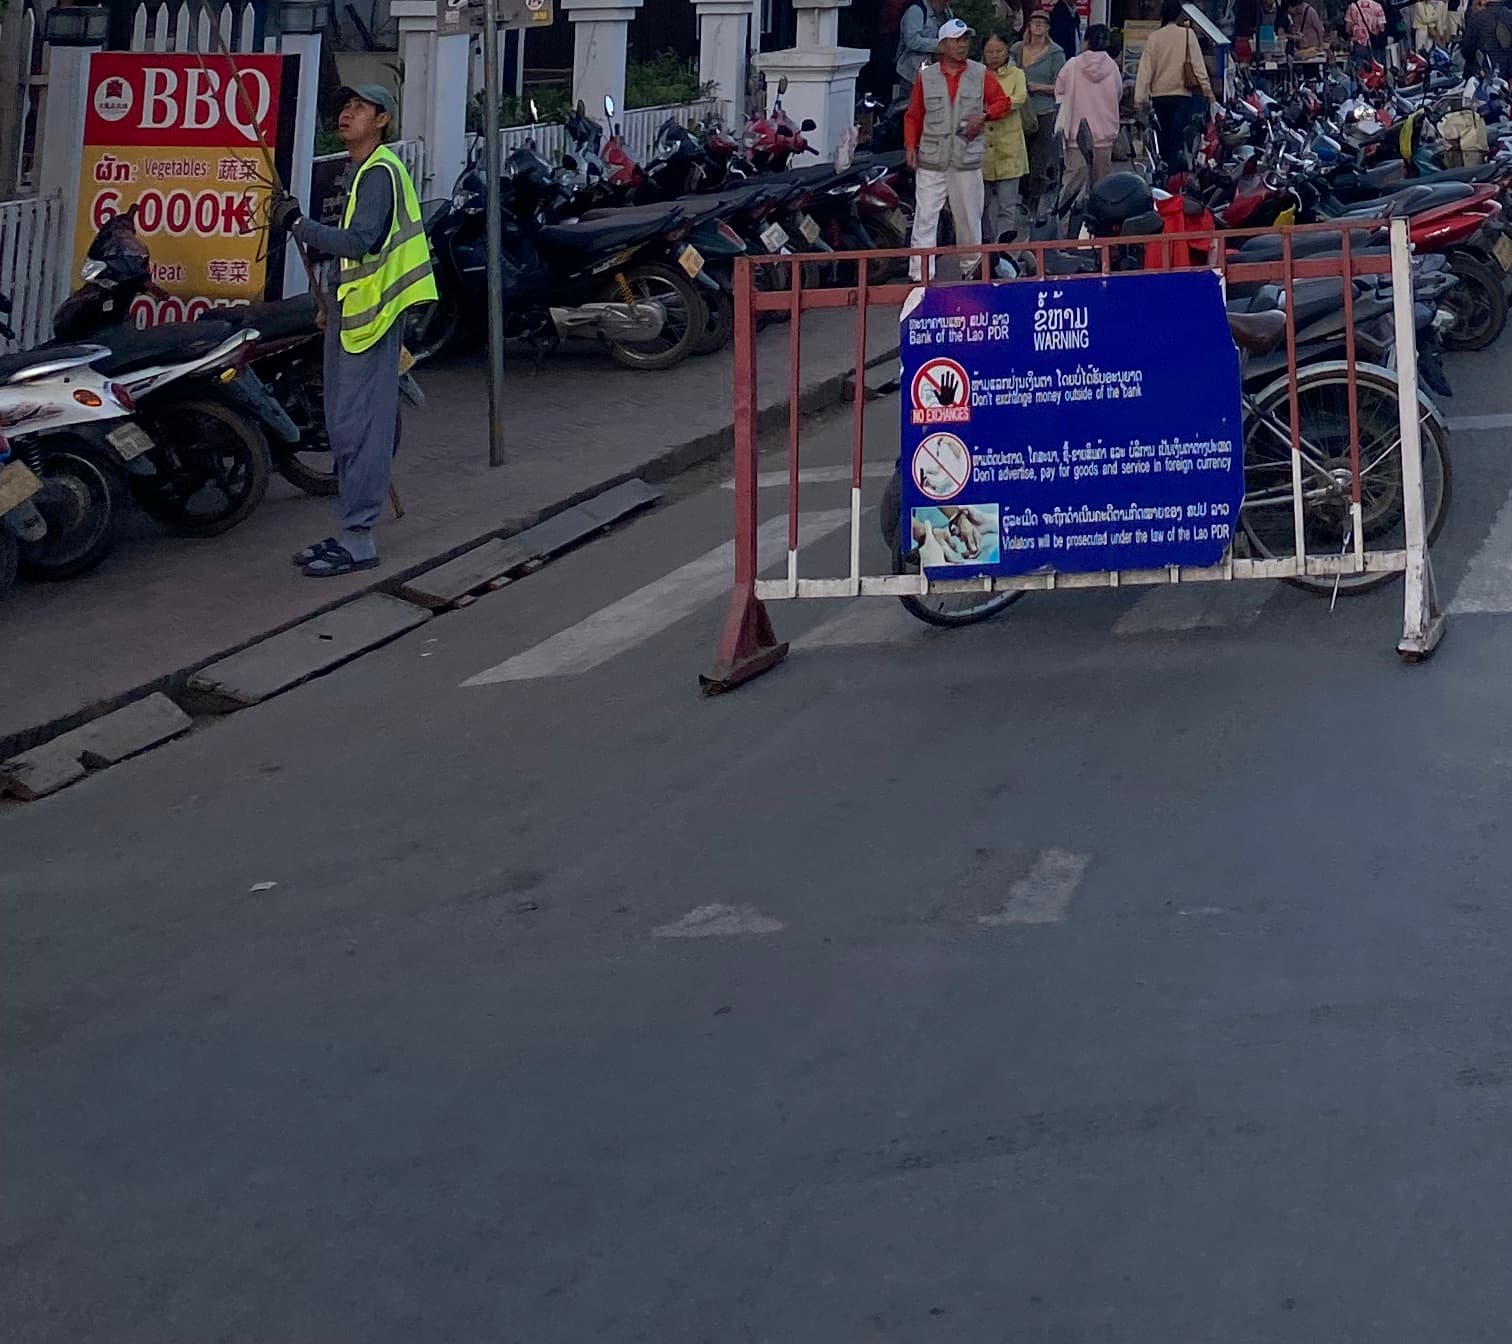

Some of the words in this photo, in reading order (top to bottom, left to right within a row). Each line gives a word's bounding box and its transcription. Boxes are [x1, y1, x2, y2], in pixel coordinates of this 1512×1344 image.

[137, 67, 271, 142] BBQ
[218, 159, 259, 181] 蔬菜
[208, 261, 249, 282] 荤菜
[909, 330, 932, 345] Bank
[936, 328, 945, 343] of
[949, 328, 963, 343] the
[967, 328, 984, 342] Lao
[988, 326, 1009, 340] PDR
[1033, 329, 1089, 351] WARNING
[972, 392, 993, 406] Don't
[995, 391, 1032, 407] exchange
[1036, 391, 1061, 406] money
[1064, 386, 1092, 401] outside
[1096, 385, 1104, 400] of
[1107, 384, 1119, 399] the
[1123, 383, 1142, 398] bank
[912, 409, 924, 423] NO
[973, 467, 995, 482] Don't
[998, 466, 1037, 481] advertise,
[1040, 466, 1055, 482] pay
[1058, 462, 1070, 477] for
[1073, 462, 1098, 480] goods
[1102, 460, 1118, 475] and
[1122, 460, 1150, 474] service
[1154, 458, 1162, 472] in
[1165, 457, 1193, 474] foreign
[1196, 457, 1232, 472] currency
[1002, 535, 1035, 550] Violators
[1038, 533, 1050, 548] will
[1053, 532, 1063, 548] be
[1066, 530, 1107, 551] prosecuted
[1110, 529, 1132, 544] under
[1135, 528, 1147, 543] the
[1150, 528, 1164, 542] law
[1167, 526, 1175, 542] of
[1178, 526, 1190, 541] the
[1193, 525, 1208, 540] Lao
[1211, 524, 1230, 540] PDR
